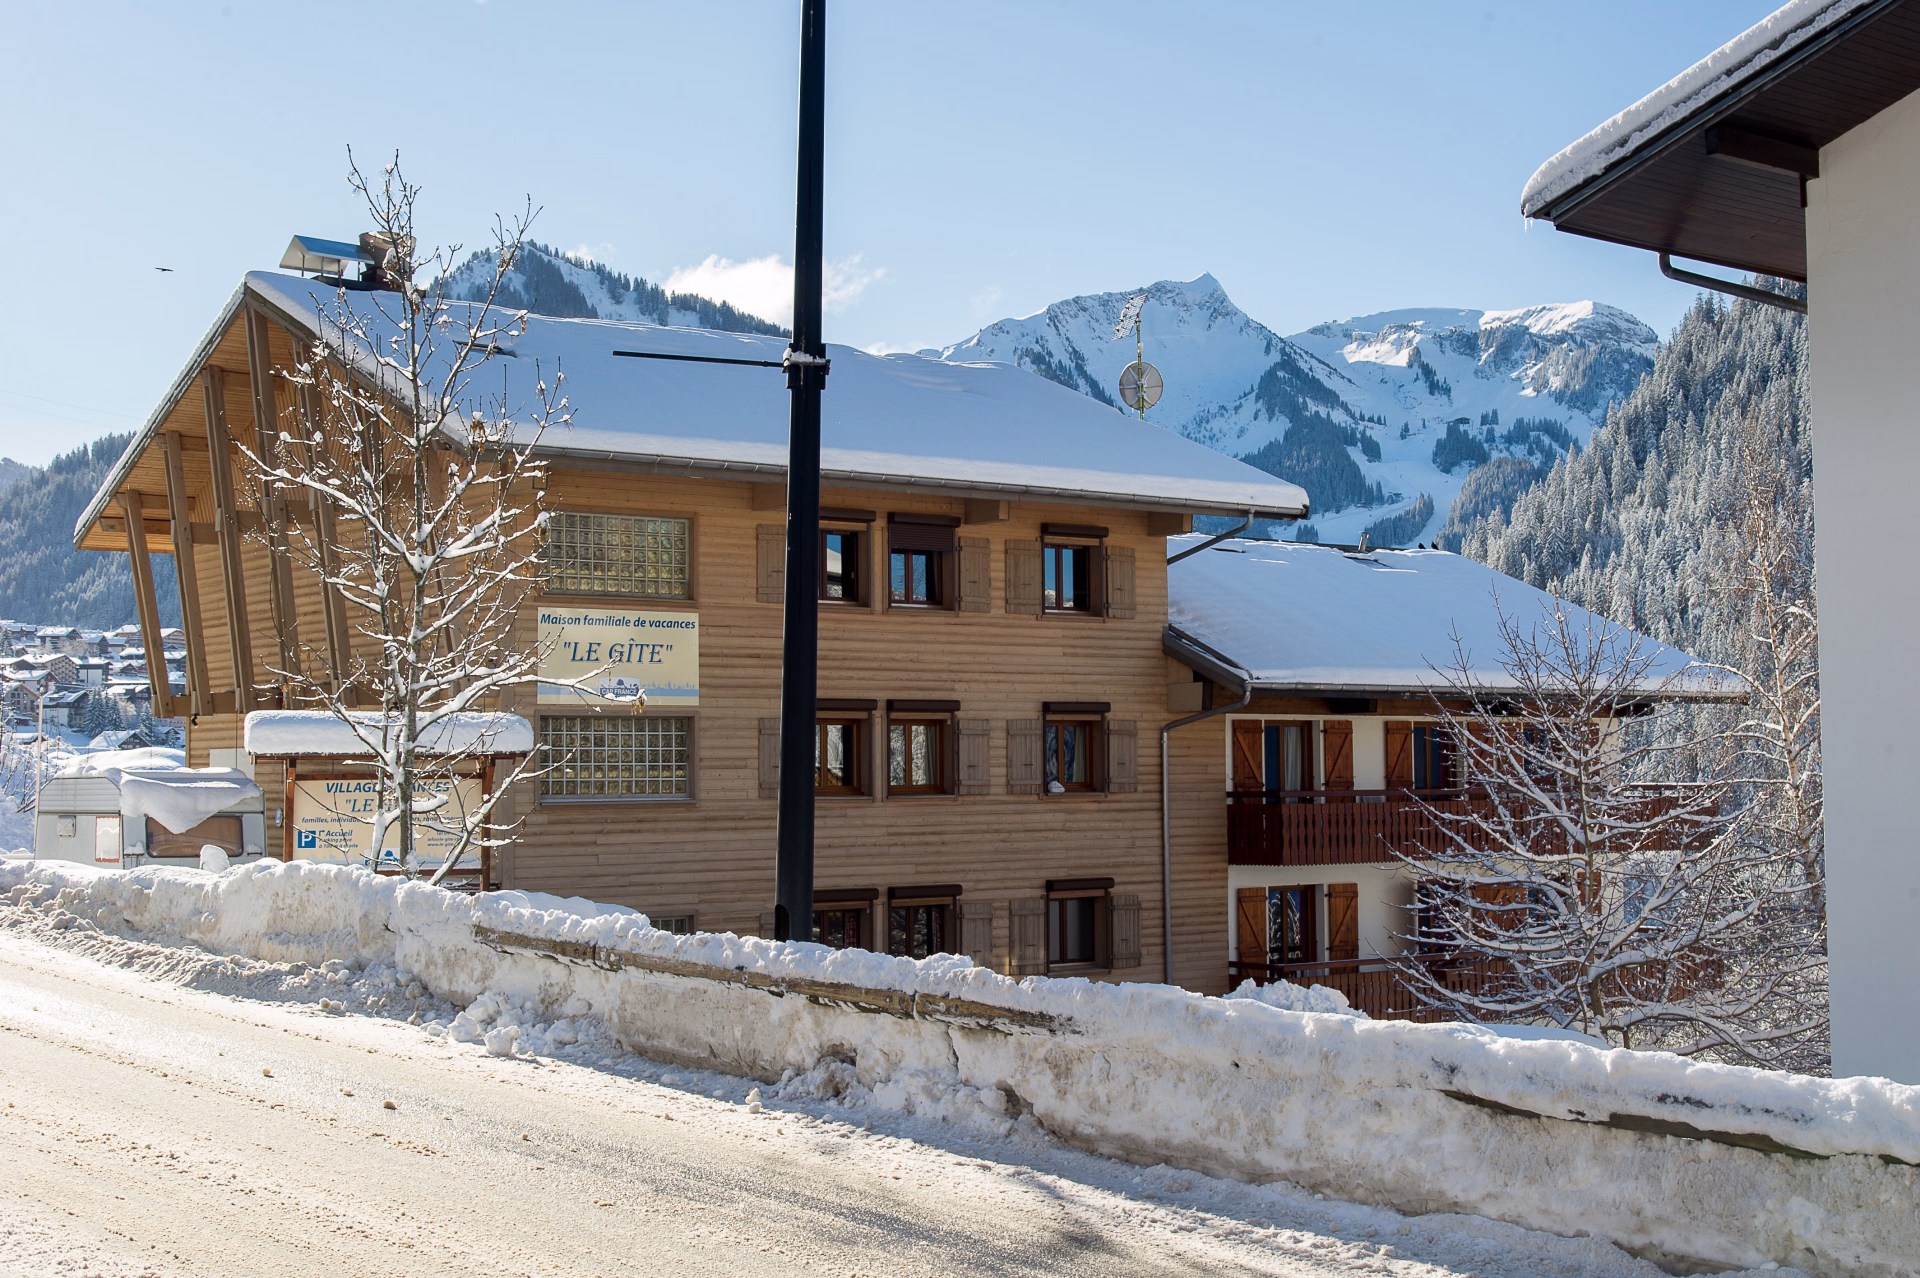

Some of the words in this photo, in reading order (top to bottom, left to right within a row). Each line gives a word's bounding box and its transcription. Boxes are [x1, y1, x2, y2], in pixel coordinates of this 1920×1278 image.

[540, 613, 581, 625] Maison
[583, 615, 631, 627] familiale
[633, 617, 646, 628] de
[649, 620, 696, 630] vacances
[563, 641, 602, 662] "LE
[608, 638, 674, 663] GÎTE"
[345, 798, 375, 813] "LE
